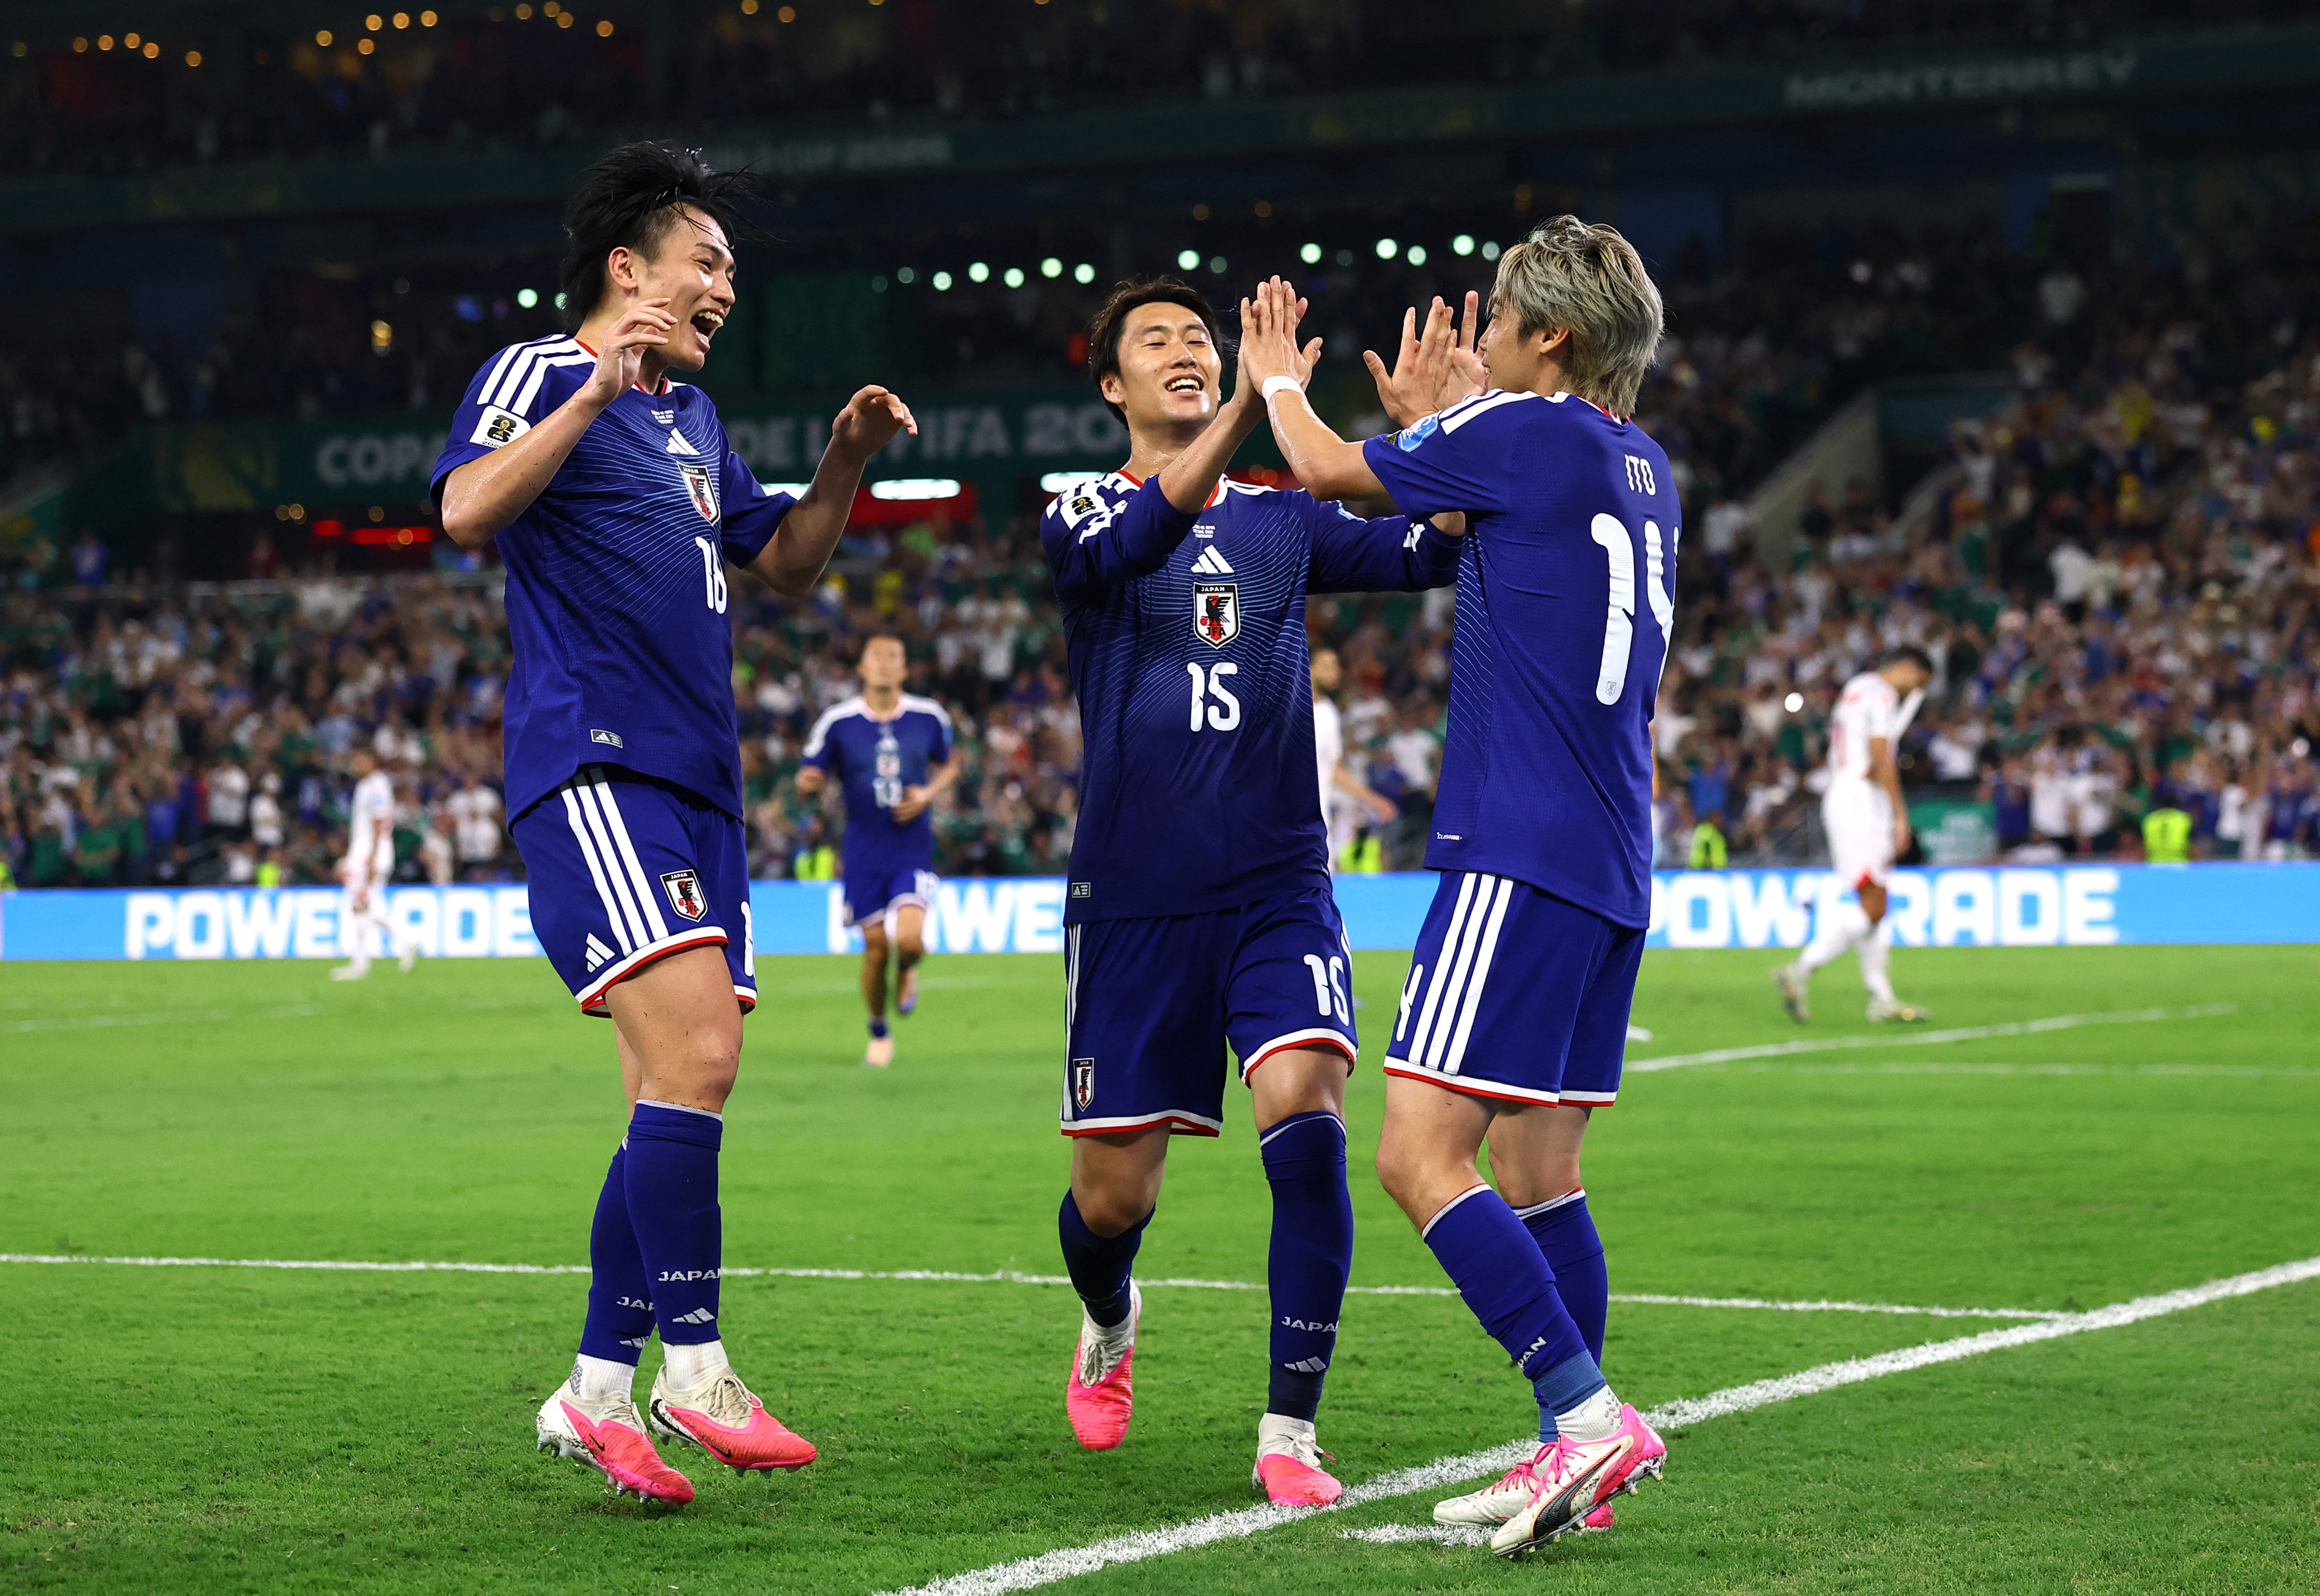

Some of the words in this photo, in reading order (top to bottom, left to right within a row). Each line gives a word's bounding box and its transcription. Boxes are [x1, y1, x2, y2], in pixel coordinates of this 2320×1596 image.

[1784, 48, 2138, 106] MONTERREY
[1023, 404, 1129, 459] 20
[1625, 454, 1656, 496] ITO
[695, 536, 727, 614] 16
[1590, 513, 1679, 705] 14
[1187, 662, 1240, 732] 15
[1304, 954, 1350, 1026] 15
[1396, 964, 1423, 1042] 4
[1282, 1316, 1340, 1332] JAPA
[1517, 1336, 1547, 1370] PAN
